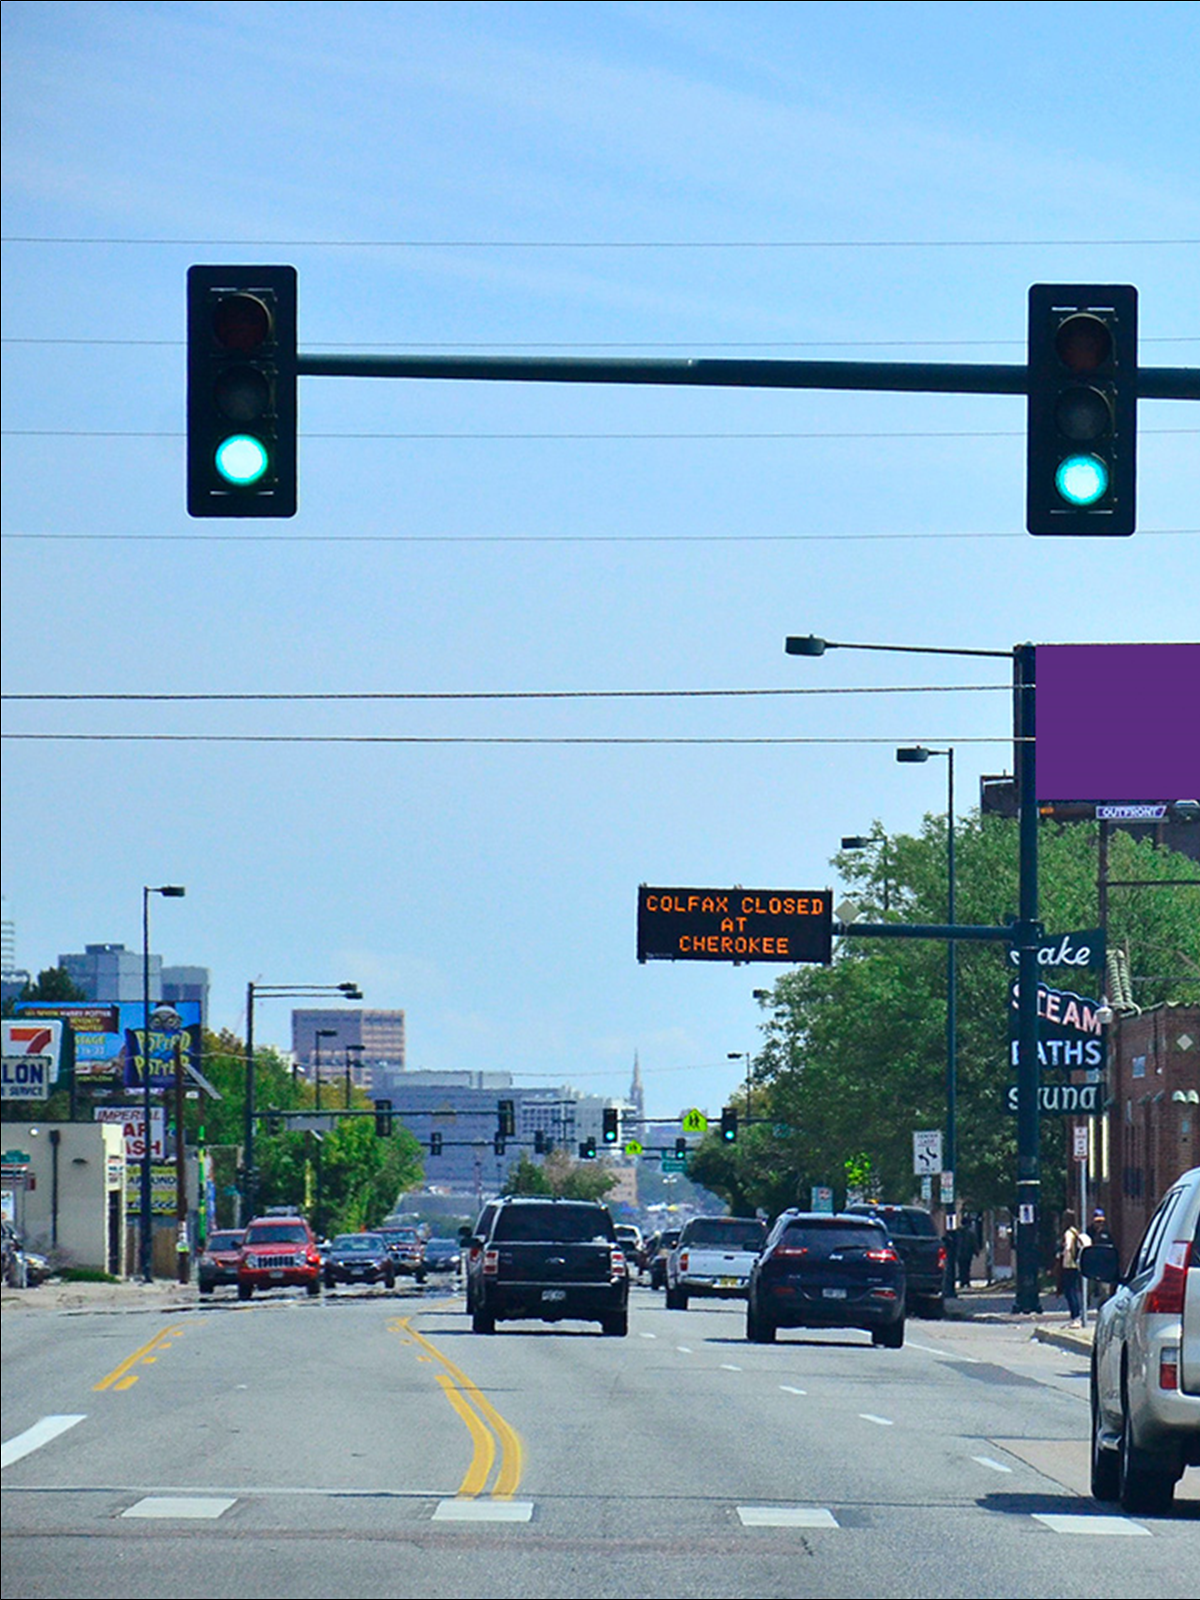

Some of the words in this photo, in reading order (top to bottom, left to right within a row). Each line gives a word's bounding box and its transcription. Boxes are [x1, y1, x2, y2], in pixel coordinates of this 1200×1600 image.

[1102, 806, 1155, 818] OUTFRONT
[646, 895, 729, 914] COLFAX
[741, 897, 824, 916] CLOSED
[720, 917, 748, 933] AT
[679, 935, 790, 955] CHEROKEE
[10, 1028, 52, 1054] 7
[1009, 1086, 1096, 1109] Suna
[97, 1109, 160, 1121] IMPERL
